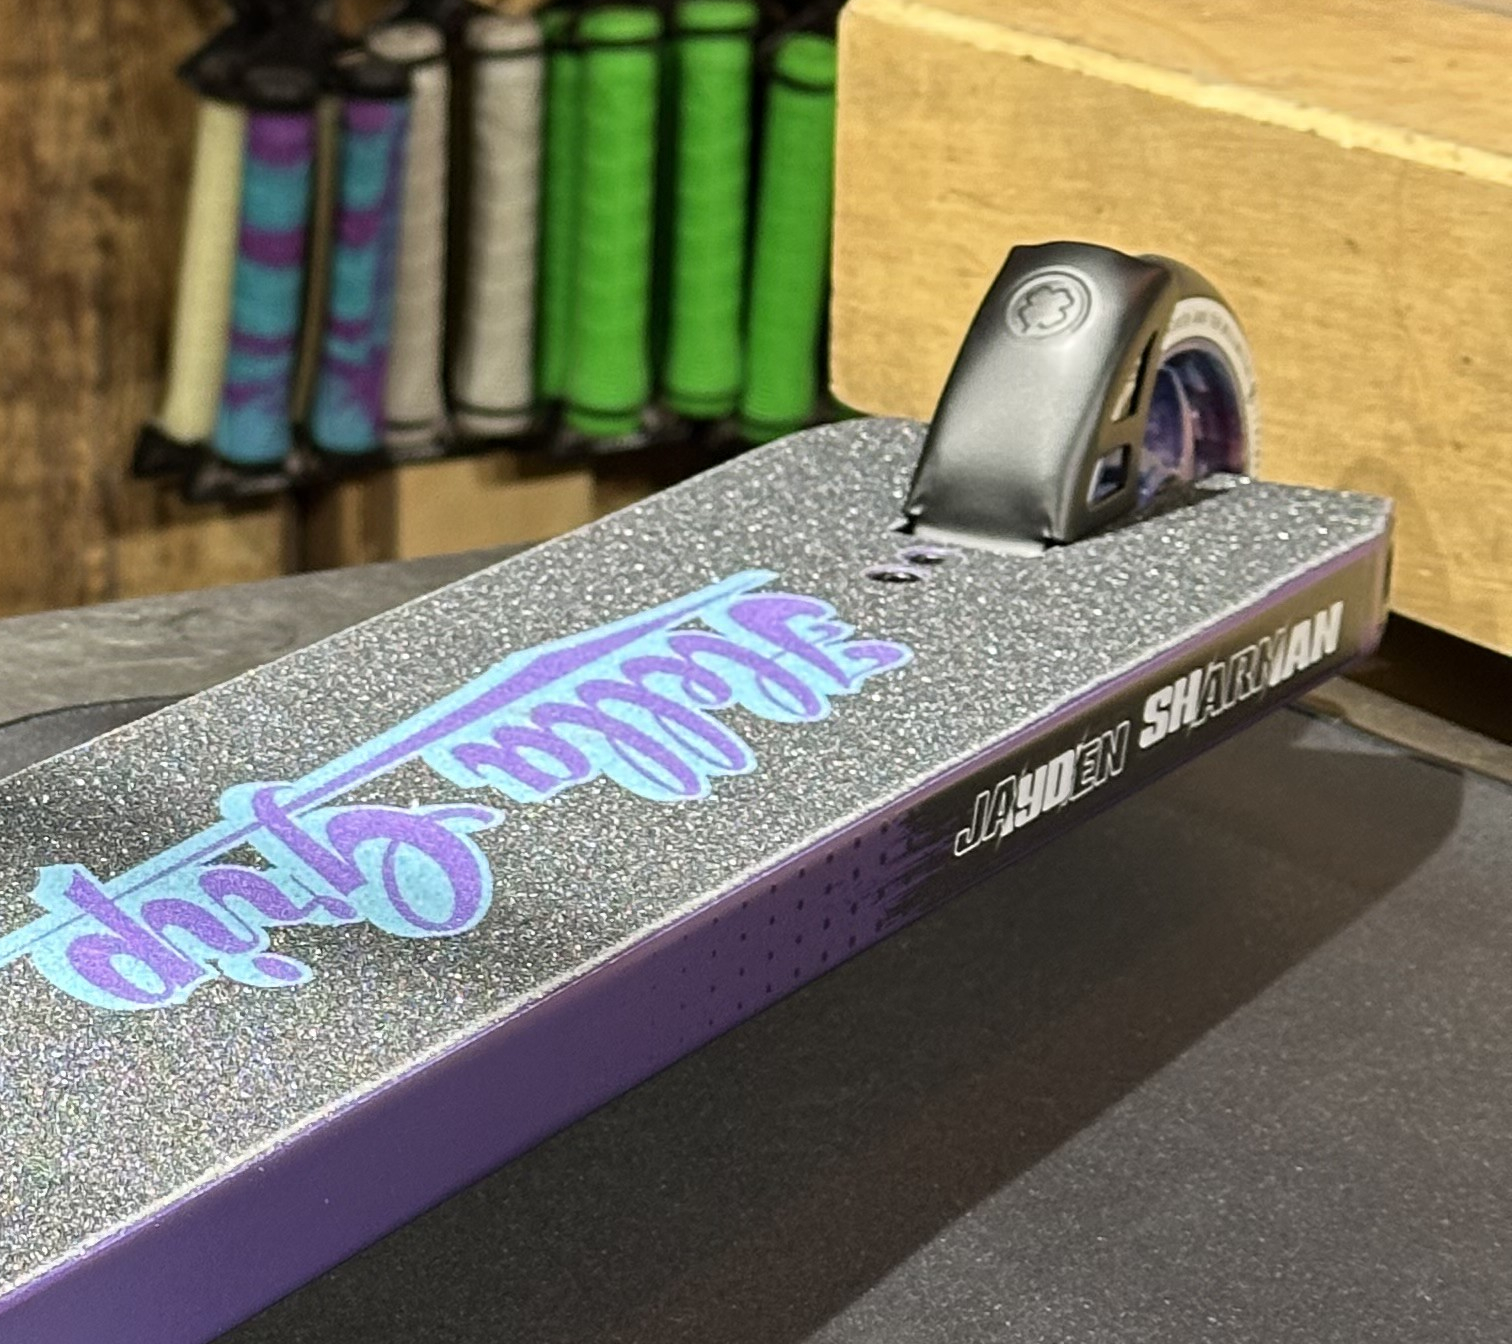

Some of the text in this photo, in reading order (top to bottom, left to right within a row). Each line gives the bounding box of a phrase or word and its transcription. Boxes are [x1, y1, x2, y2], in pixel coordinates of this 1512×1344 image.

[23, 586, 912, 1012] Hella Grip
[954, 599, 1345, 857] JAYDEN SHARMAN
